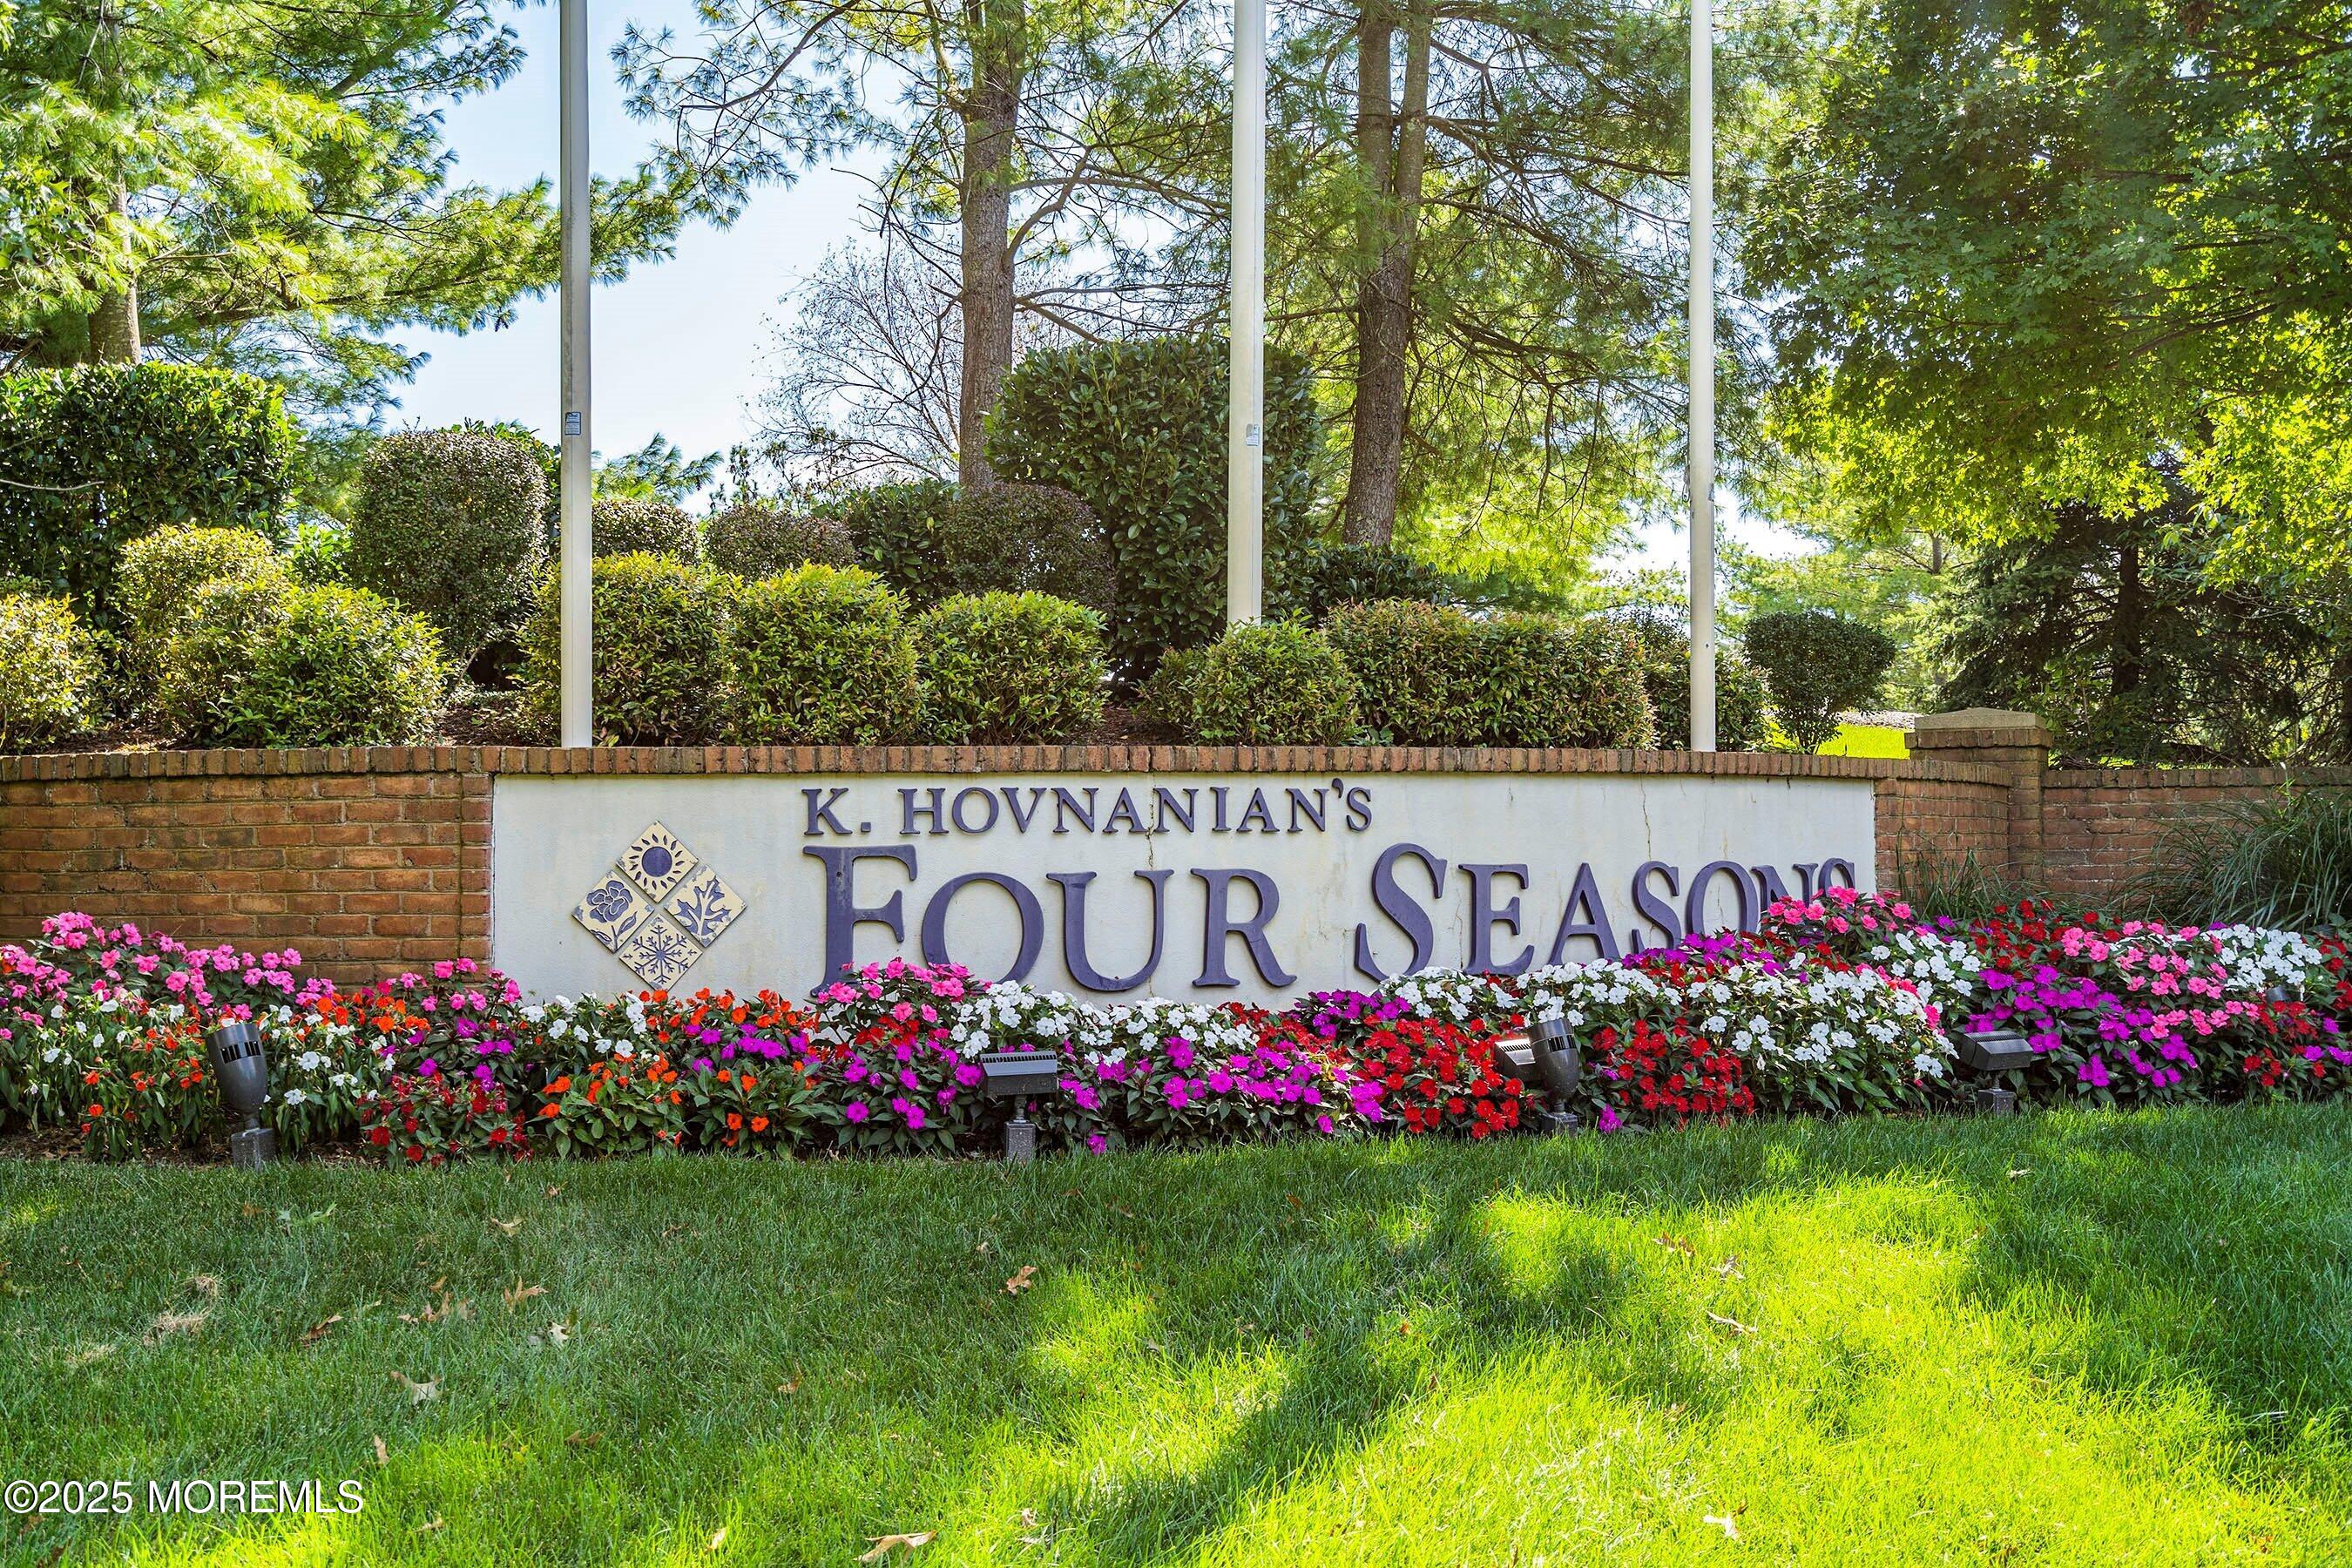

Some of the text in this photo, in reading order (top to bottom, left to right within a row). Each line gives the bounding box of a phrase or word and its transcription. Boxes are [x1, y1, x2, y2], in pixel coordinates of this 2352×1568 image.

[802, 777, 1374, 836] K. HOVNANIAN'S
[802, 843, 1298, 998] FOUR
